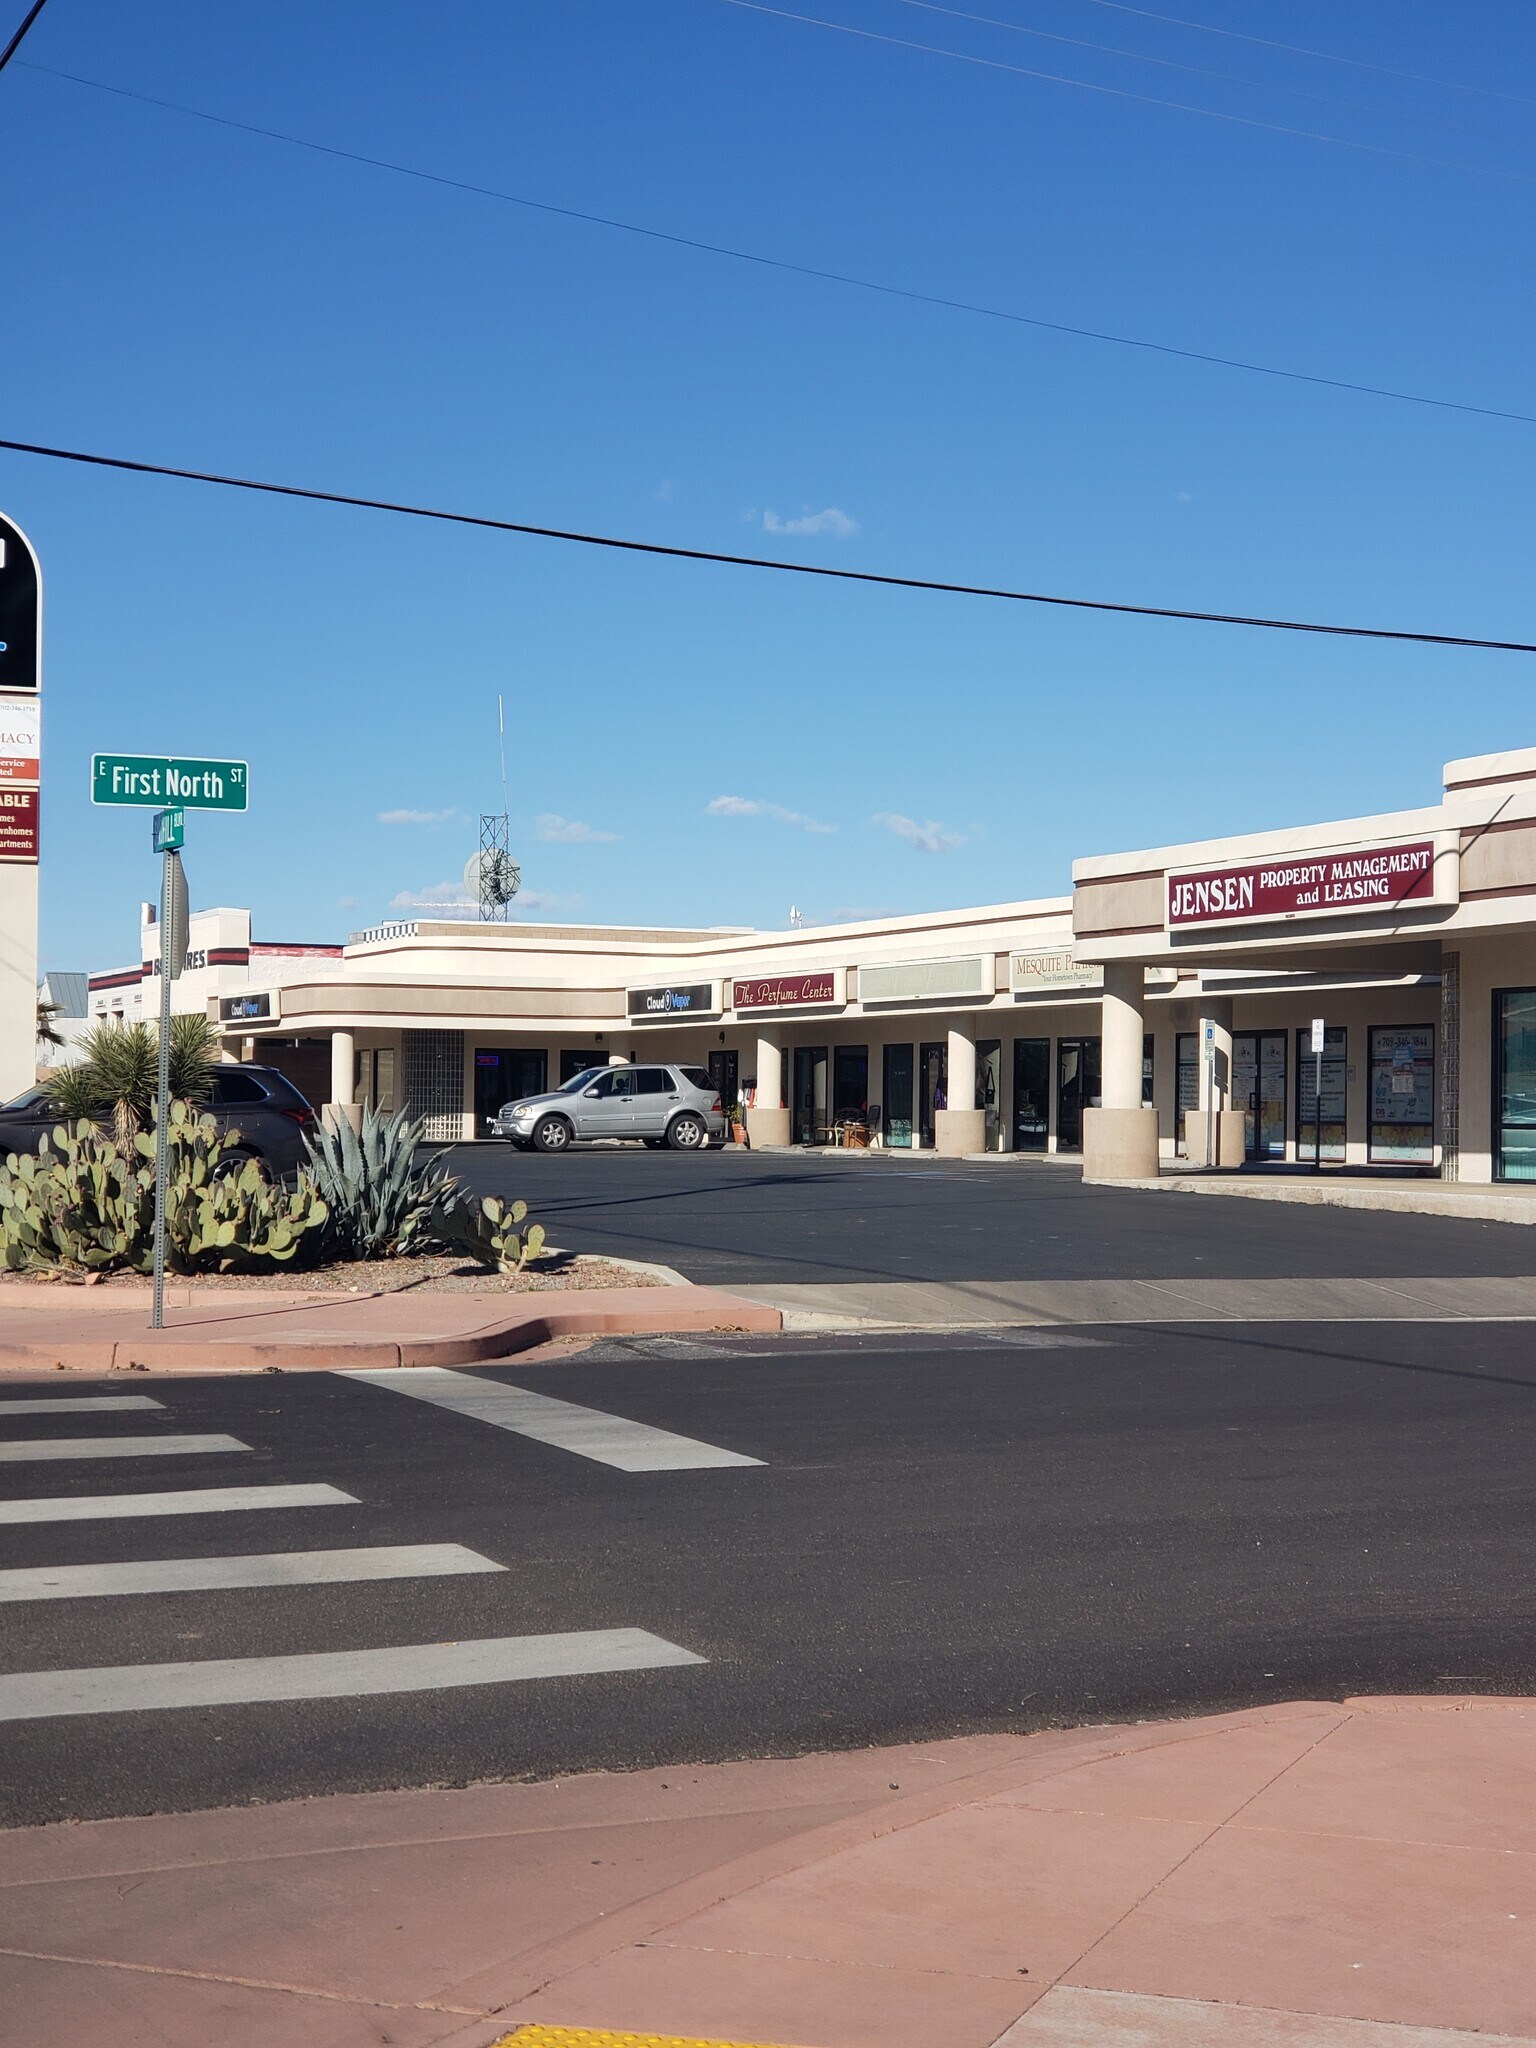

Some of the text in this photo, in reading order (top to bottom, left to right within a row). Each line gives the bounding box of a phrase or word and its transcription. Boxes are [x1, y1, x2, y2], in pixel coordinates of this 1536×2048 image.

[100, 761, 243, 798] E First North ST
[1260, 851, 1430, 888] PROPERTY MANAGEMENT
[1171, 876, 1254, 916] JENSEN
[1296, 877, 1389, 904] and LEASING
[183, 950, 205, 970] IRES
[1017, 957, 1061, 975] MESQUITE
[647, 995, 665, 1010] Cloud
[671, 993, 690, 1011] Vapor
[736, 979, 832, 1005] The Perfume Center
